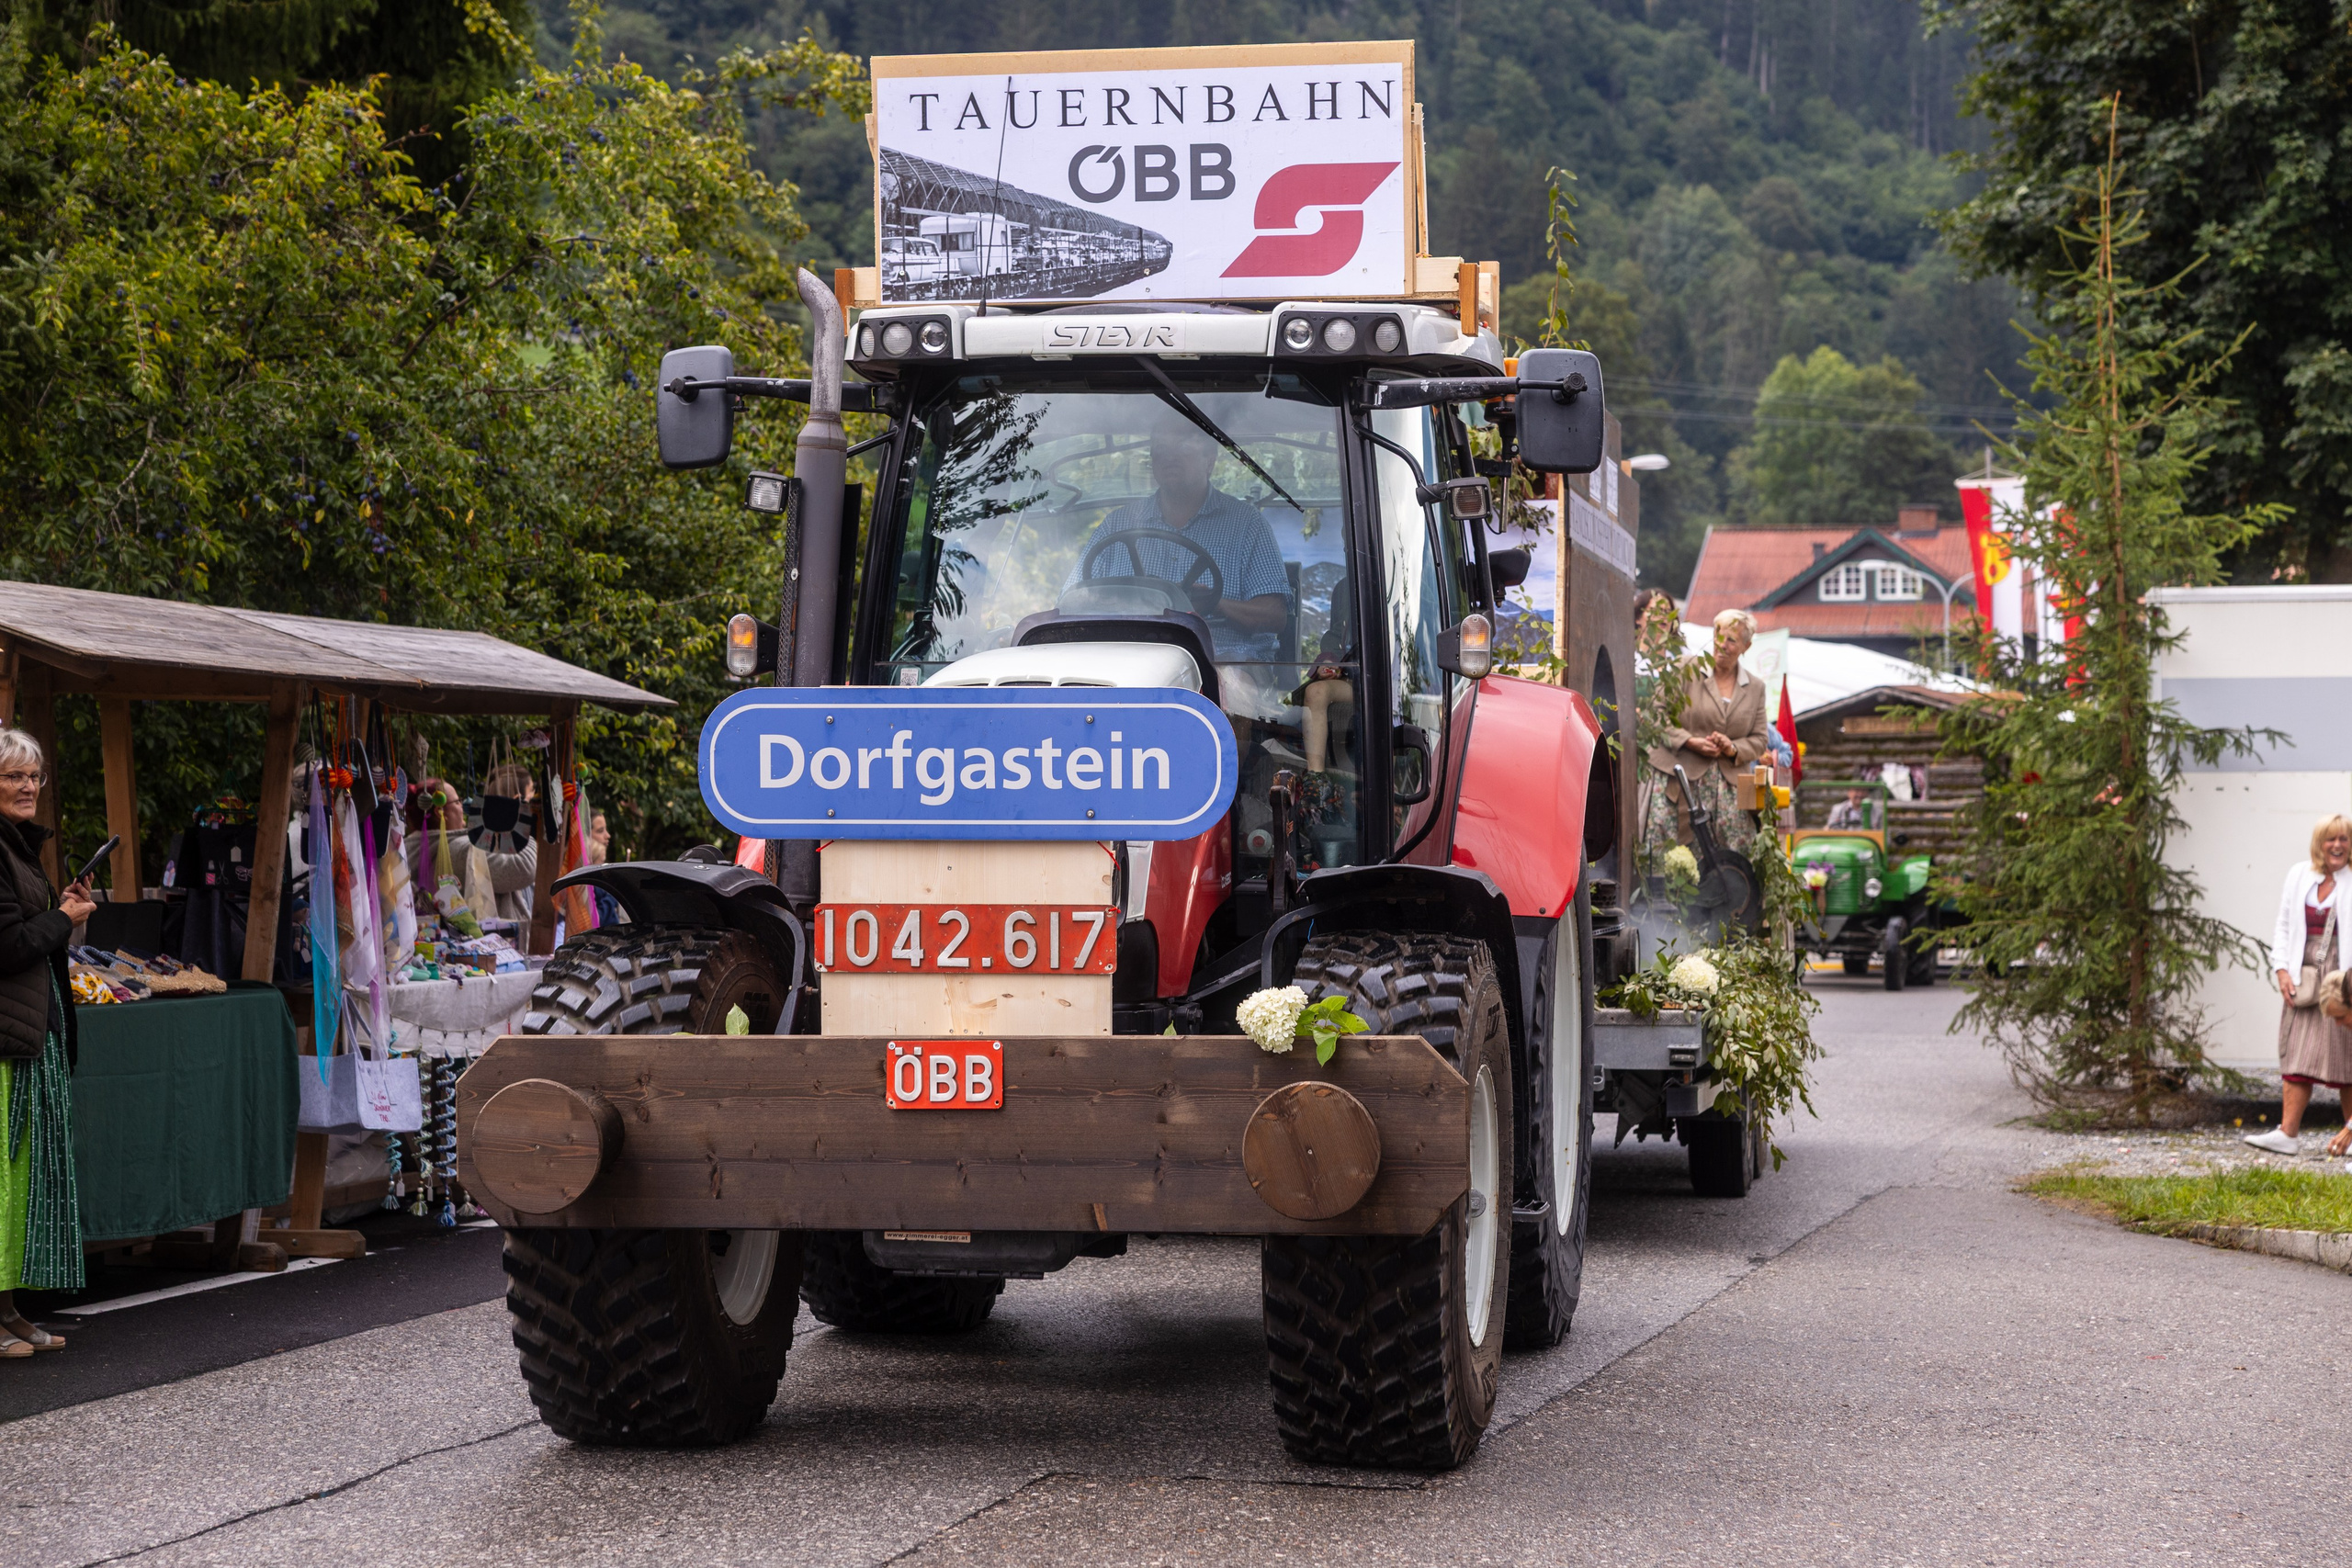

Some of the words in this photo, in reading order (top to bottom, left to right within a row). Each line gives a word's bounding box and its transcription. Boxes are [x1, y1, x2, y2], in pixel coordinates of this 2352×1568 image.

[909, 80, 1394, 131] TAUERNBAHN
[1068, 142, 1237, 203] ÖBB
[1048, 325, 1177, 347] STEYR
[758, 730, 1170, 806] Dorfgastein
[823, 909, 1104, 969] 1042.617
[894, 1046, 993, 1102] ÖBB
[887, 1232, 968, 1241] www.zimmerei-egger.at
